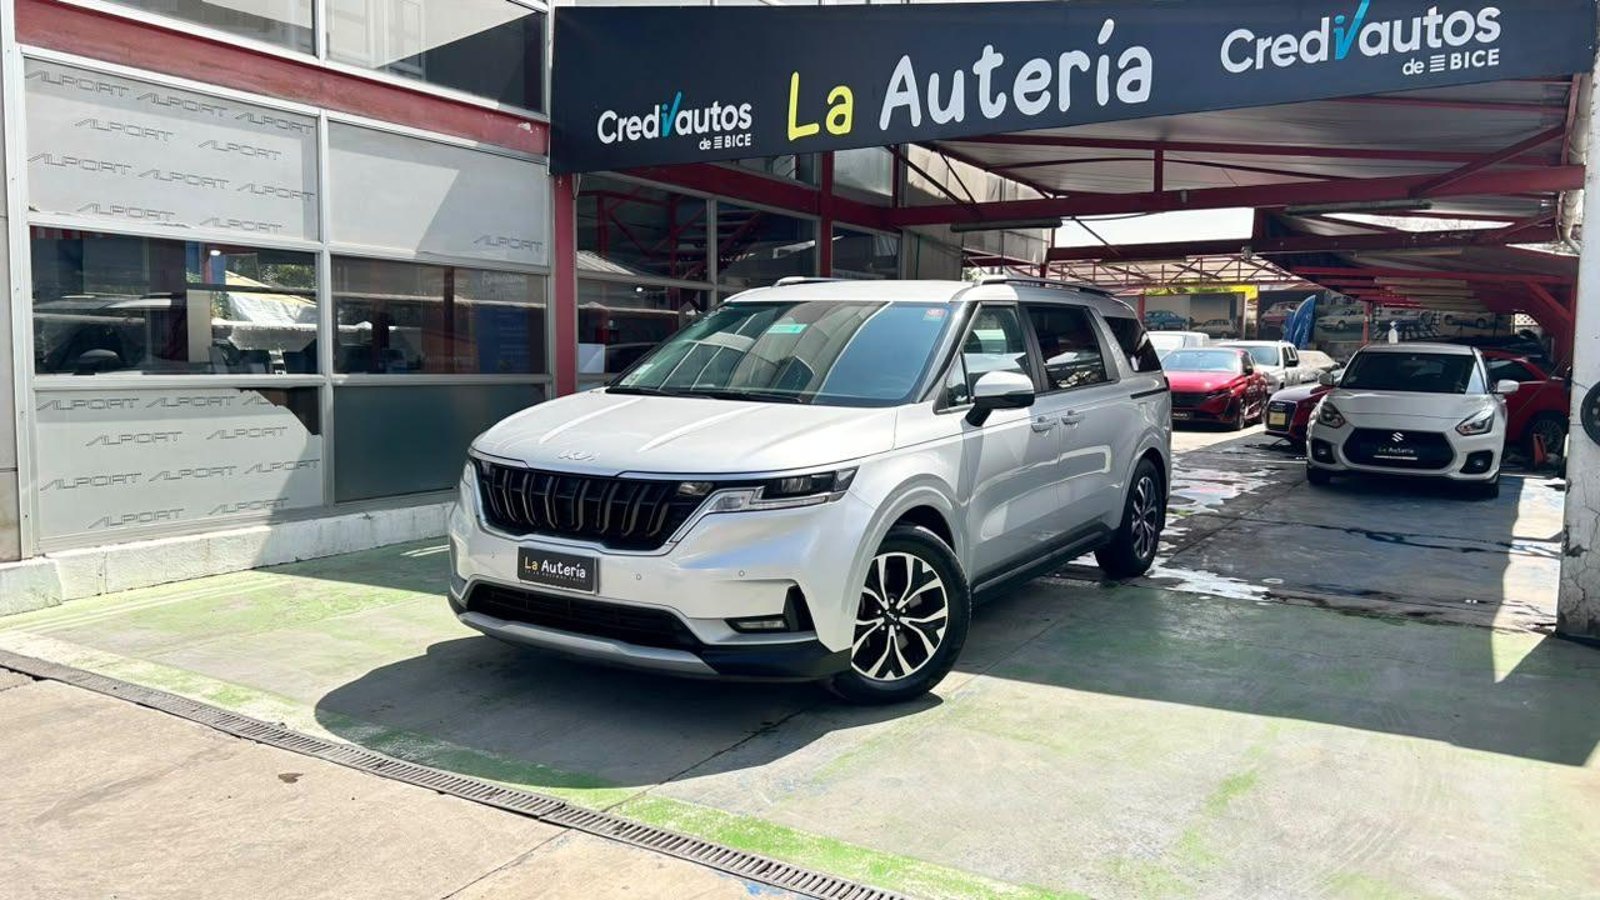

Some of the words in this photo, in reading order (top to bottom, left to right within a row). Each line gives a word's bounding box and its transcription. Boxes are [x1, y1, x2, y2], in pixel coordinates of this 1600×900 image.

[1402, 58, 1424, 76] de
[1449, 49, 1500, 71] BICE
[787, 72, 854, 141] La
[879, 19, 1152, 132] Autería
[25, 70, 129, 97] ALPORT
[137, 92, 228, 118] ALPORT
[235, 112, 315, 135] ALPORT
[75, 118, 173, 142] ALPORT
[198, 139, 282, 161] ALPORT
[699, 137, 711, 150] de
[724, 133, 751, 148] BICE
[27, 153, 131, 175] ALPORT
[138, 169, 229, 189] ALPORT
[237, 183, 316, 202] ALPORT
[77, 202, 175, 222] ALPORT
[199, 217, 282, 234] ALPORT
[36, 398, 139, 411] ALPORT
[146, 395, 236, 408] ALPORT
[85, 431, 183, 447] ALPORT
[206, 426, 288, 441] ALPORT
[39, 472, 142, 491] ALPORT
[149, 466, 237, 482] ALPORT
[244, 459, 321, 474] ALPORT
[88, 508, 184, 529] ALPORT
[208, 497, 289, 515] ALPORT
[525, 556, 538, 571] La
[541, 559, 586, 579] Autería
